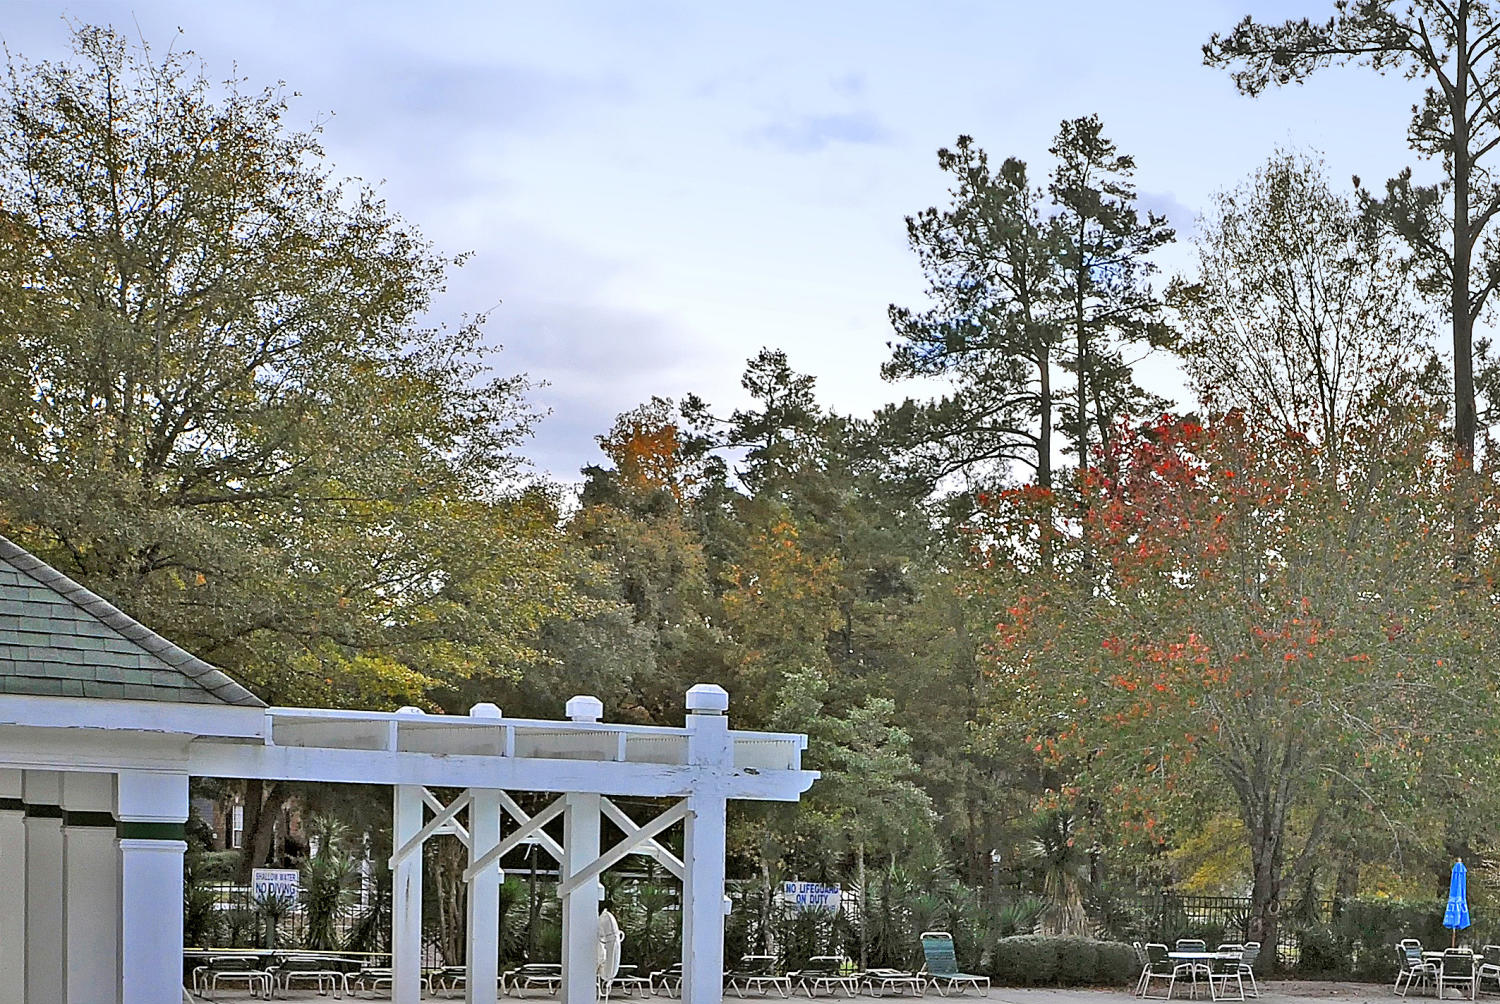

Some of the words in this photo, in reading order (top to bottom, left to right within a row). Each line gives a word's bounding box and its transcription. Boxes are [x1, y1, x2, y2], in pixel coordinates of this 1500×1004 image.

[255, 872, 279, 881] SHALLOW
[280, 873, 296, 881] WATER
[256, 882, 267, 893] NO
[269, 883, 296, 895] DIVING
[786, 883, 796, 893] NO
[796, 894, 807, 904] ON
[810, 895, 828, 904] DUTY
